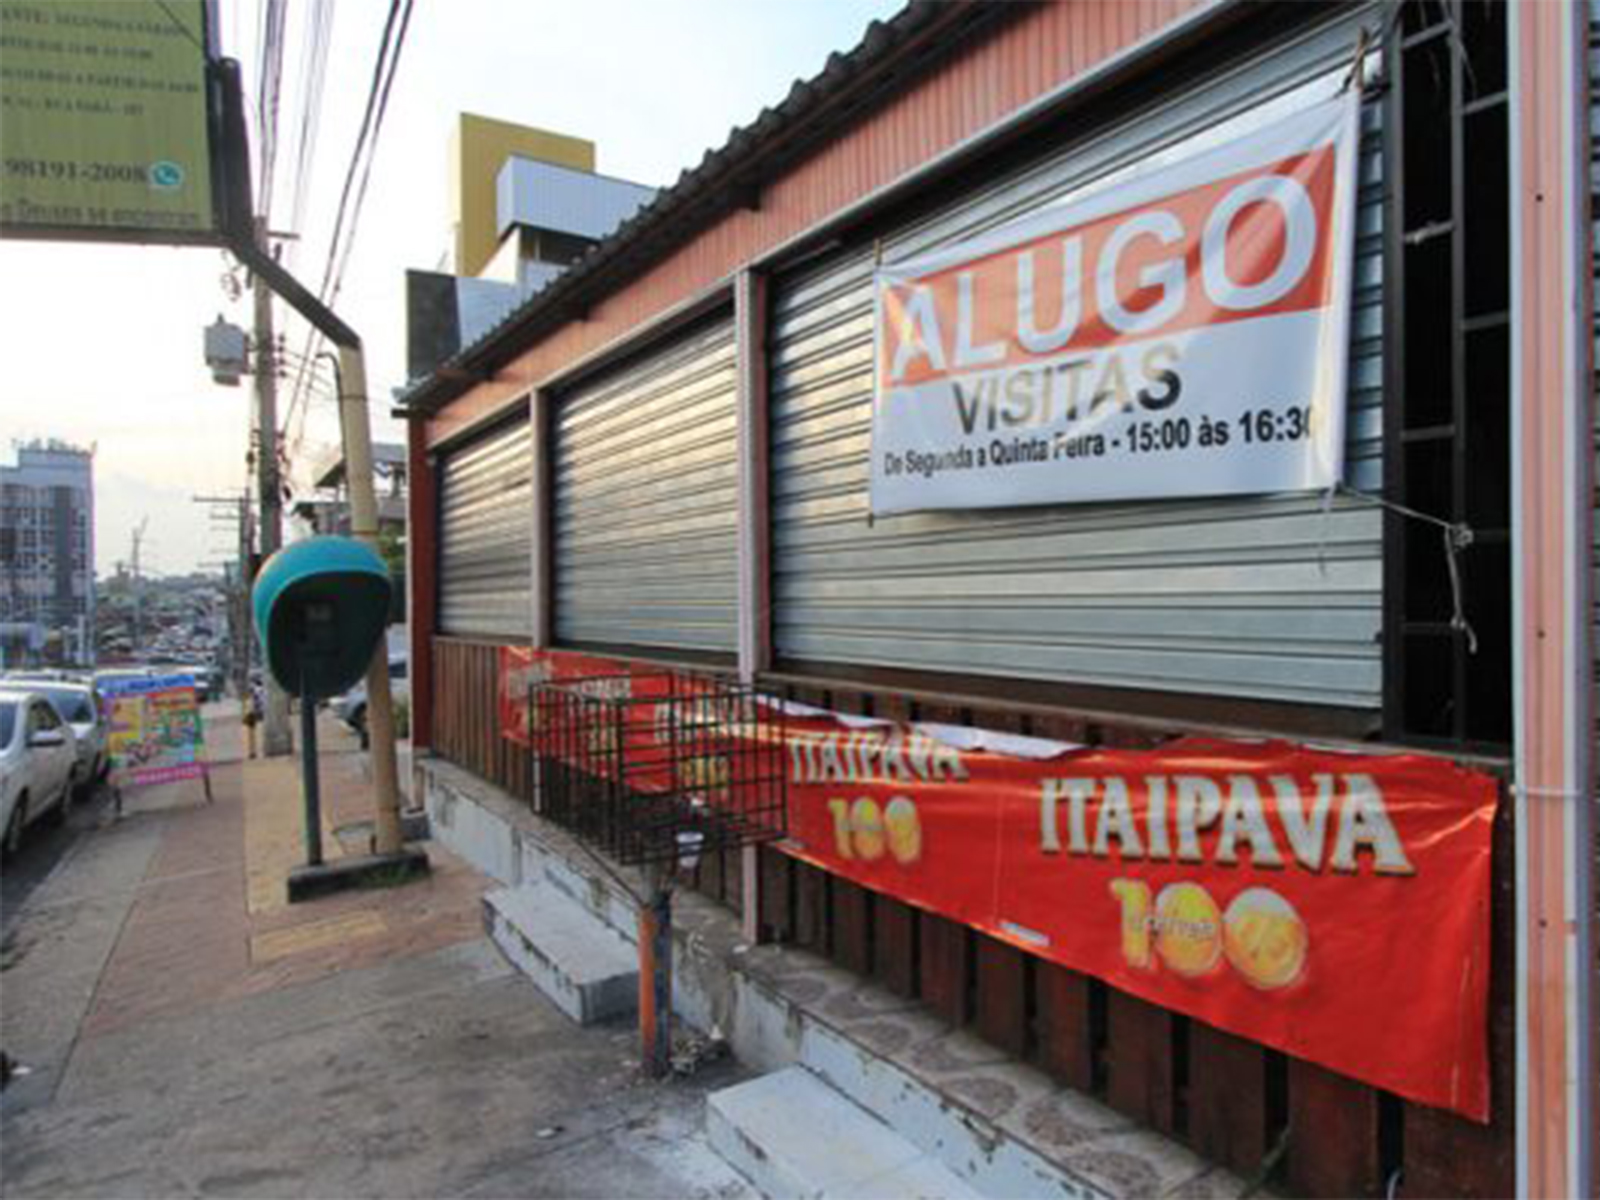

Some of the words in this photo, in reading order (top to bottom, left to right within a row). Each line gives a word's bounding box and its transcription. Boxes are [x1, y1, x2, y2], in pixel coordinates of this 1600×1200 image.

[891, 174, 1317, 382] ALUGO
[952, 345, 1182, 434] VISITAS
[885, 452, 901, 475] De
[905, 446, 973, 478] Segunda
[977, 449, 986, 466] a
[990, 435, 1048, 465] Quinta
[1053, 429, 1105, 460] Feira
[1126, 418, 1191, 453] 15:00
[1199, 414, 1230, 446] às
[788, 730, 970, 784] ITAIPAVA
[827, 795, 922, 866] 100
[1039, 773, 1415, 876] ITAIPAVA
[1109, 879, 1310, 990] 100
